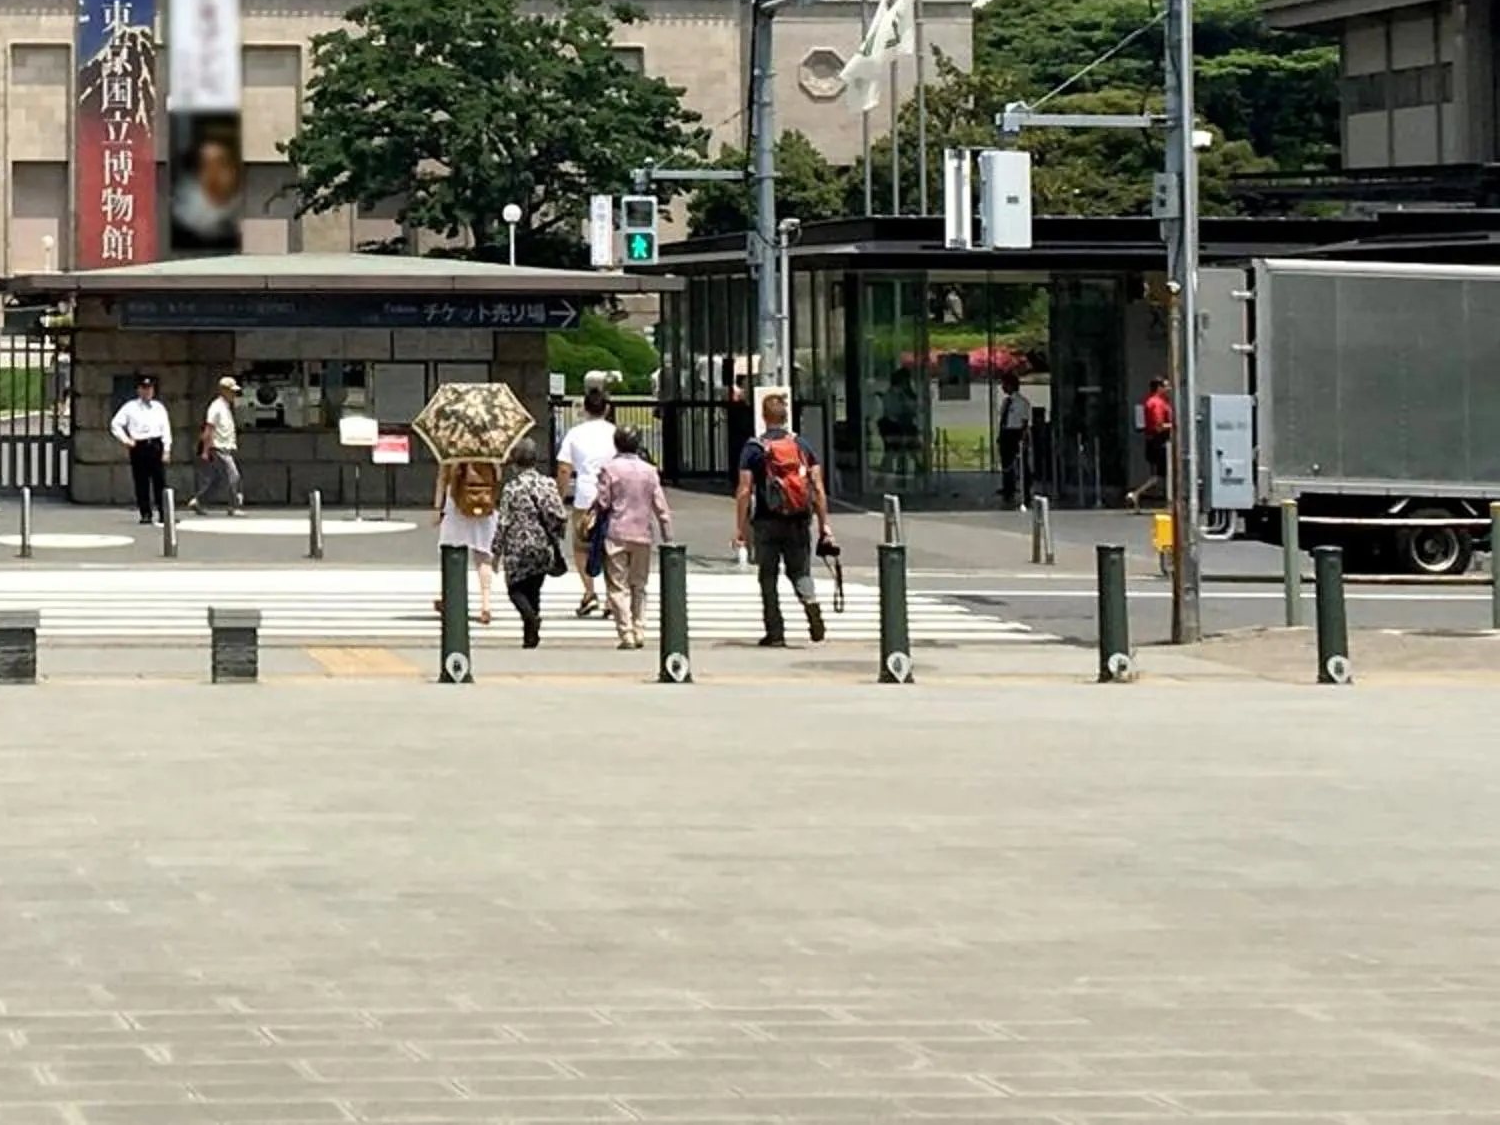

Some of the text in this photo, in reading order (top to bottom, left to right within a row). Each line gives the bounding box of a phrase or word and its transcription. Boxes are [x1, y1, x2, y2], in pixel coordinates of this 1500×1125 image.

[102, 0, 133, 260] 東京国立博物館
[424, 303, 545, 324] チケット売り場
